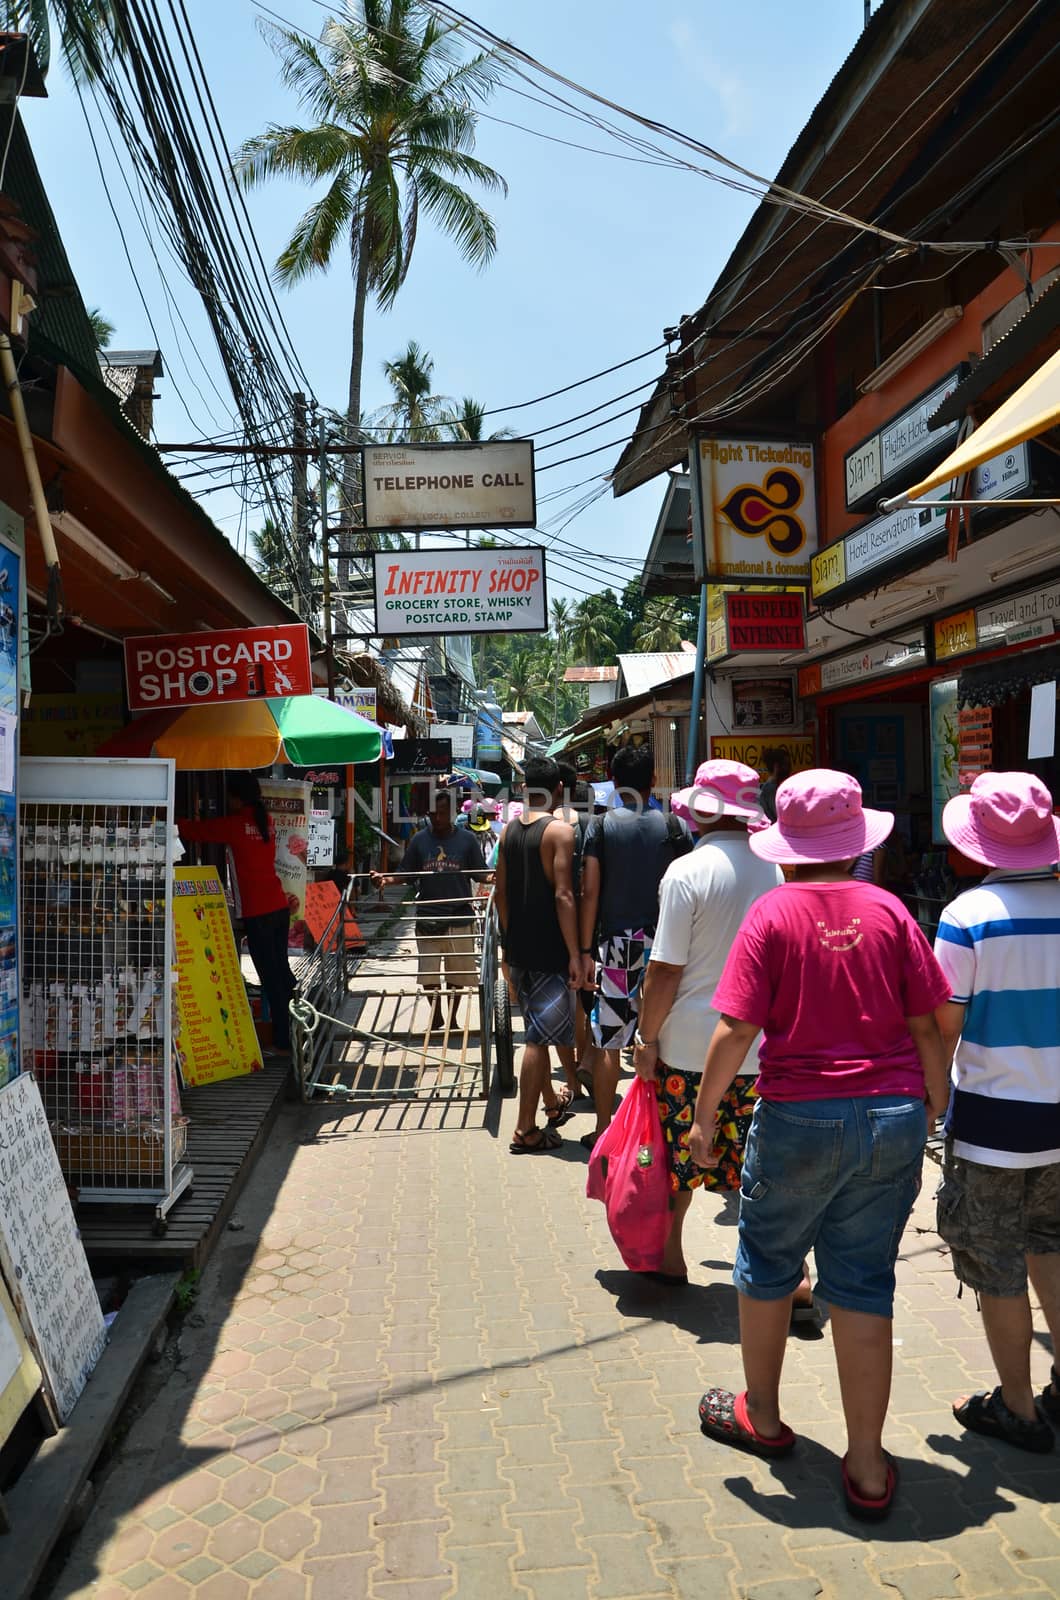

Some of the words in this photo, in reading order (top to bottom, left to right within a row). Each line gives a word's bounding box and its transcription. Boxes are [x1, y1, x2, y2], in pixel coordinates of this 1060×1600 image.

[702, 442, 743, 464] Flight
[745, 445, 812, 468] Ticketing
[374, 475, 474, 491] TELEPHONE
[482, 473, 525, 488] CALL
[849, 449, 875, 489] Siam
[848, 532, 870, 562] Hotel
[870, 511, 918, 551] Reservations
[384, 564, 484, 596] INFINITY
[488, 568, 540, 595] SHOP
[765, 561, 774, 575] &
[815, 553, 839, 585] Siam
[385, 600, 440, 610] GROCERY
[443, 598, 484, 610] STORE,
[487, 596, 533, 607] WHISKY
[752, 600, 800, 617] SPEED
[989, 600, 1017, 626] Travel
[1020, 596, 1038, 618] and
[406, 612, 471, 624] POSTCARD,
[475, 611, 513, 622] STAMP
[732, 625, 801, 644] INTERNET
[939, 620, 968, 647] Siam
[136, 639, 293, 672] POSTCARD
[139, 667, 238, 701] SHOP
